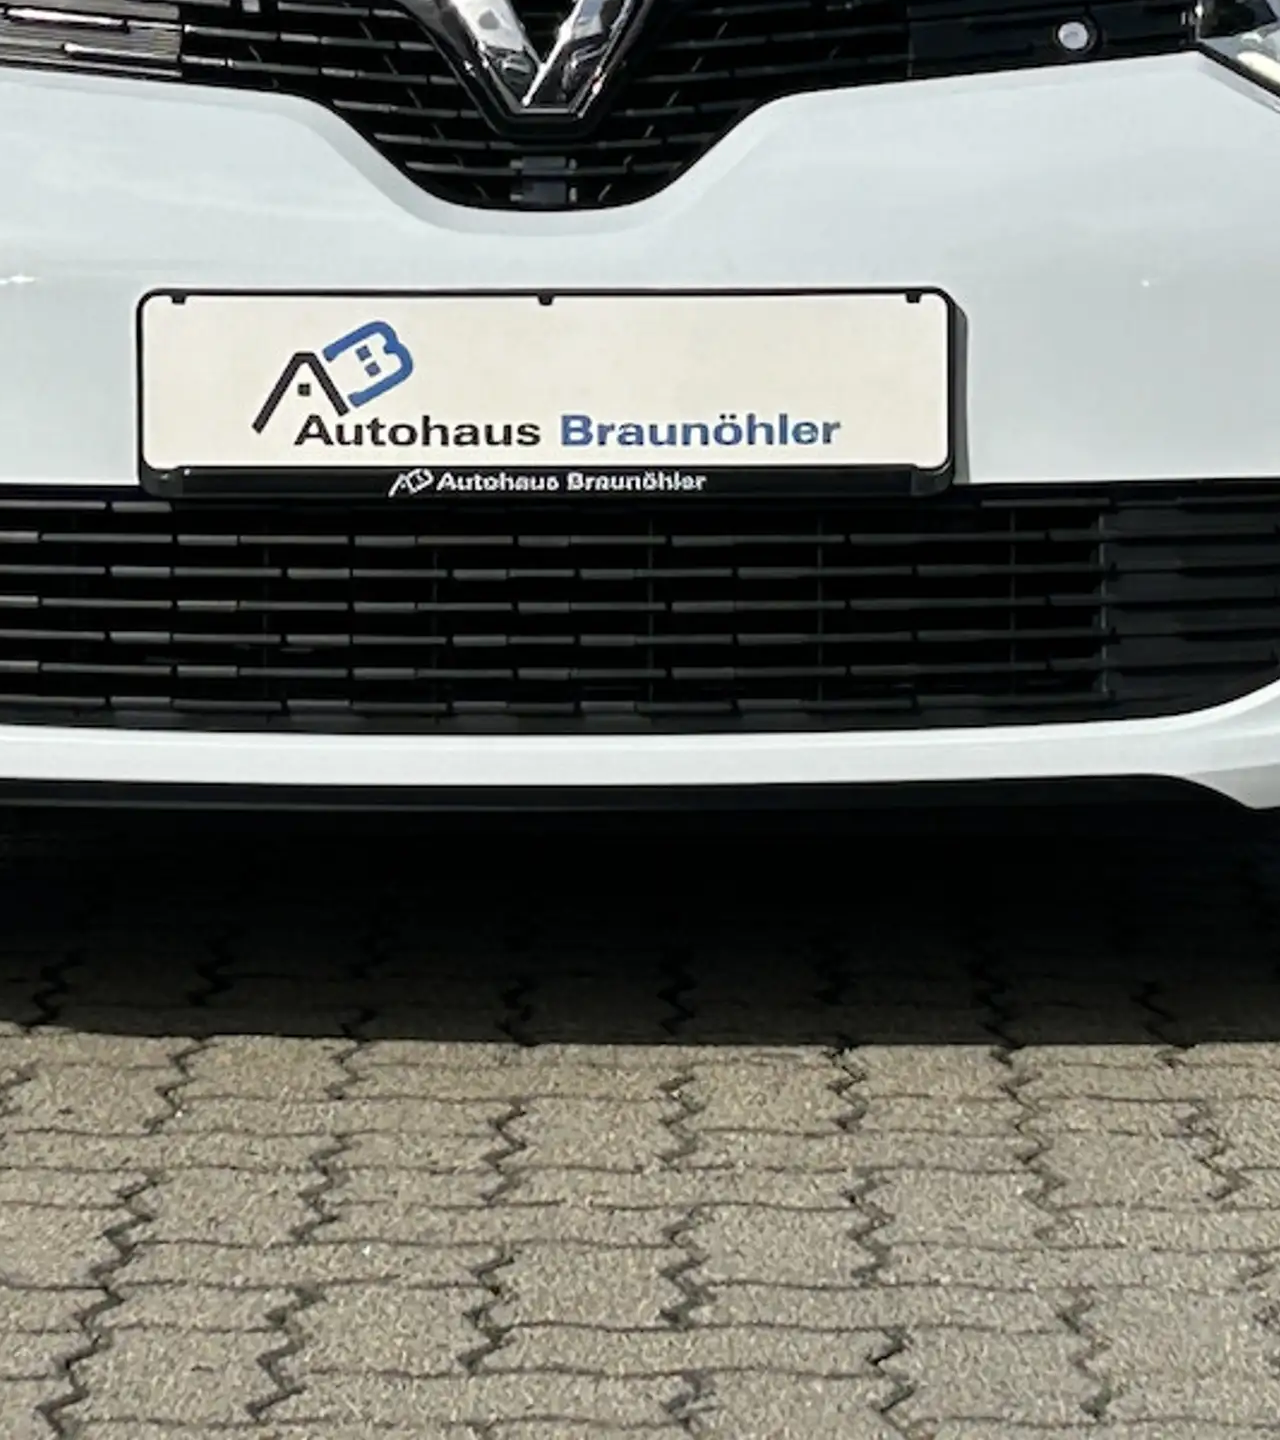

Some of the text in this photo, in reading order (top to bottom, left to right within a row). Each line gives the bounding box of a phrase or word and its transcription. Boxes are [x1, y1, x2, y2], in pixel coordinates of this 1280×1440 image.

[293, 412, 842, 449] Autohaus Braunöhler
[435, 471, 561, 493] Autohaus
[566, 469, 709, 493] Braunöhler
